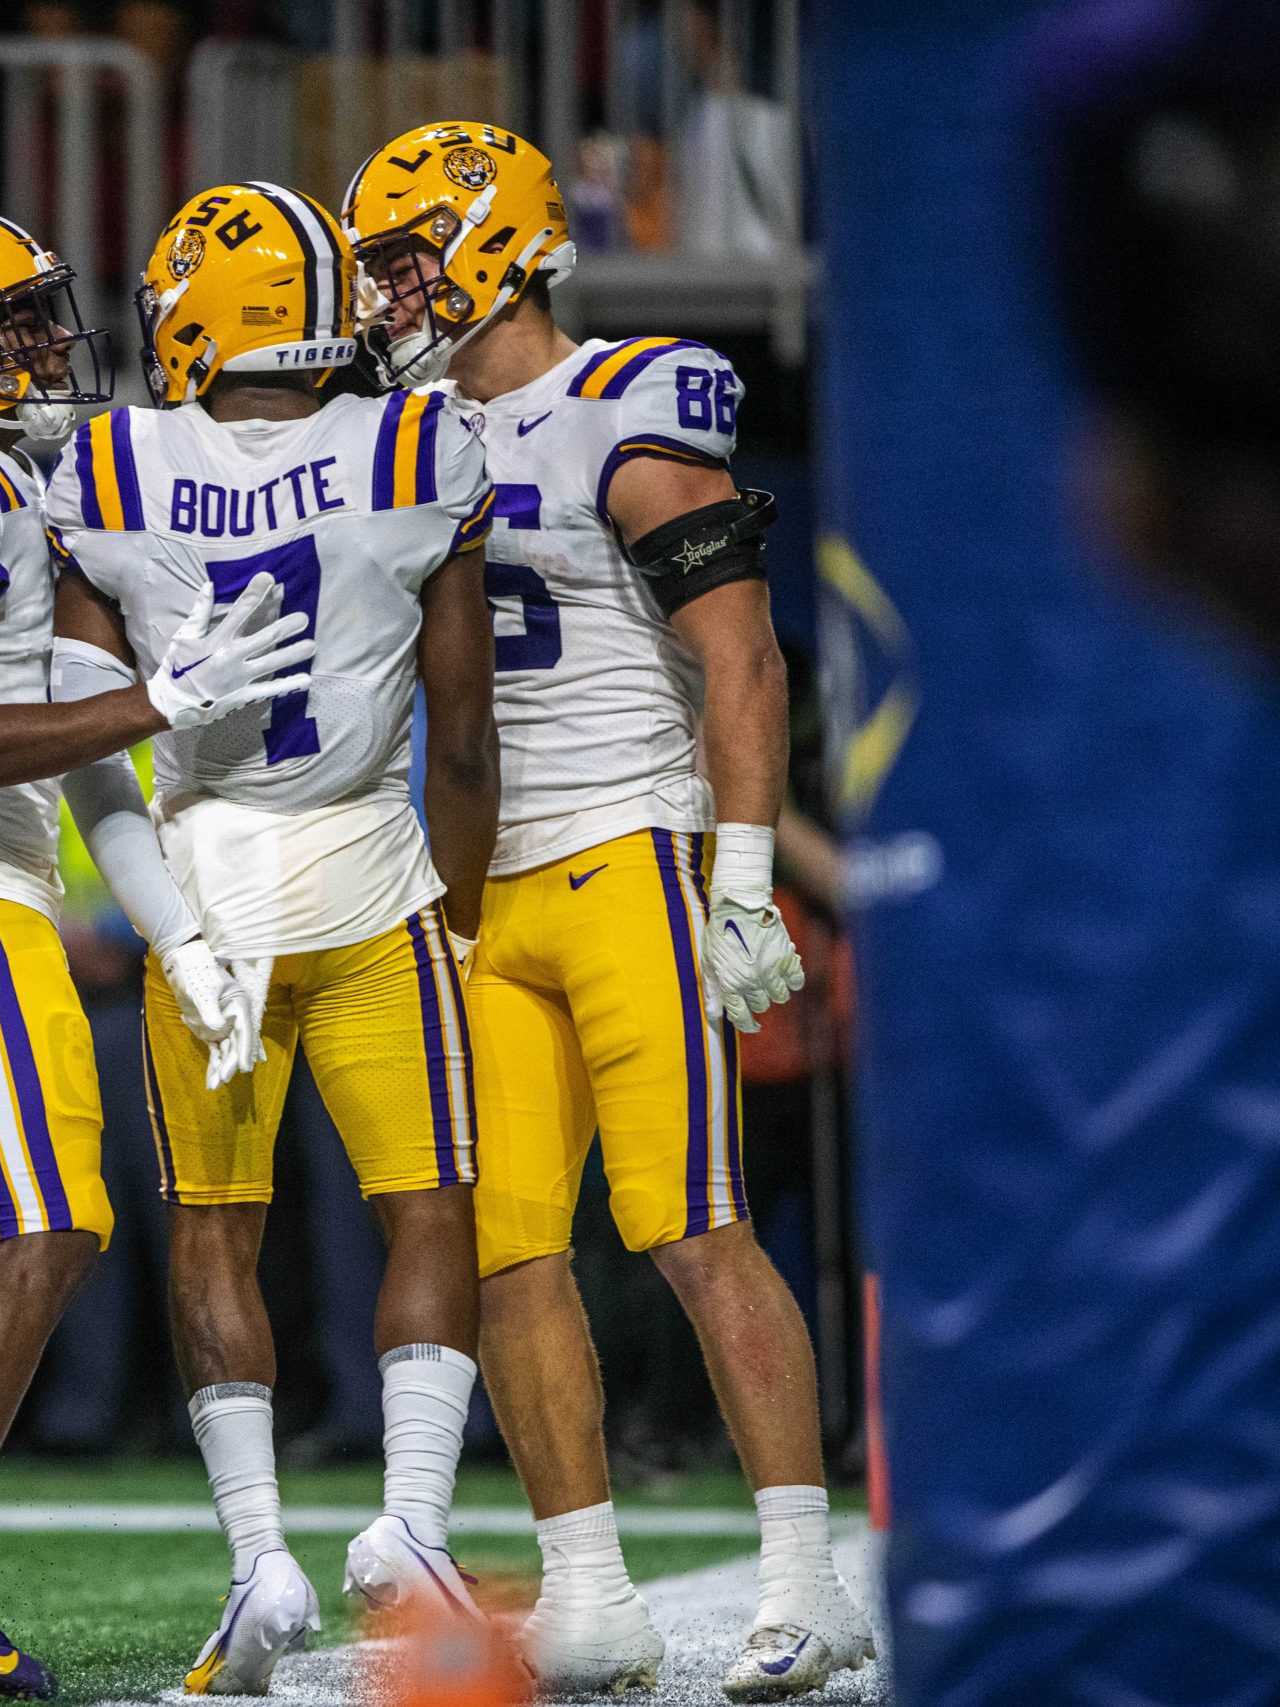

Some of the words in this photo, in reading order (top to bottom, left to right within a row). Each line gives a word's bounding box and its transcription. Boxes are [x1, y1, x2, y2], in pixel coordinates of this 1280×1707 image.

[387, 125, 517, 174] LSU
[276, 345, 355, 365] TIGERS
[675, 365, 735, 435] 86
[170, 455, 346, 538] BOUTTE
[205, 533, 322, 766] 7
